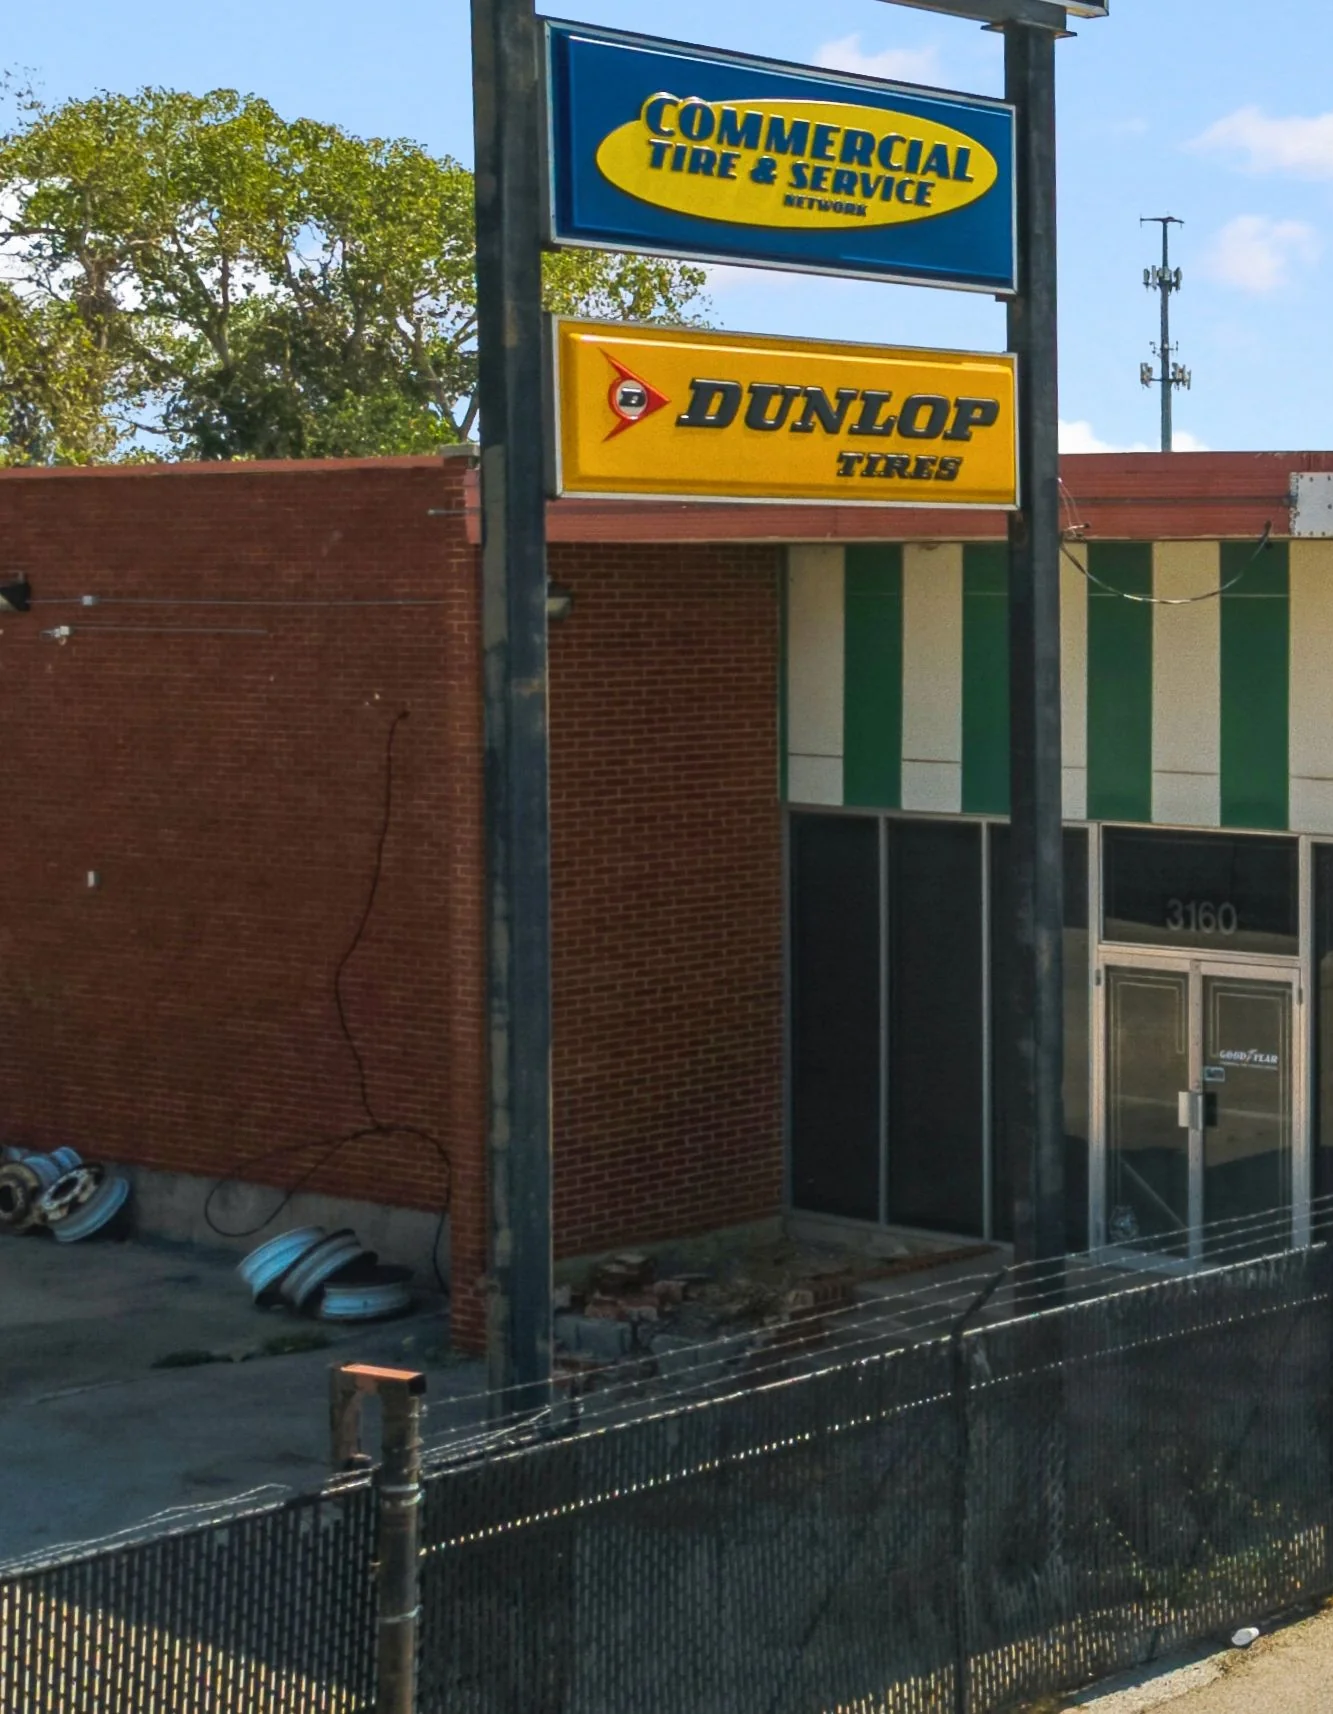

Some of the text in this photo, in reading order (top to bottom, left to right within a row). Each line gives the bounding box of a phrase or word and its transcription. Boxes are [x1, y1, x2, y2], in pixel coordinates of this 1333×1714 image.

[645, 98, 974, 182] COMMERCIAL
[648, 138, 936, 207] TIRE & SERVICE
[783, 194, 868, 217] NETWORK
[676, 378, 1000, 442] DUNLOP
[836, 452, 964, 482] TIRES
[1165, 898, 1238, 936] 3160
[1219, 1049, 1279, 1064] GOODYEAR
